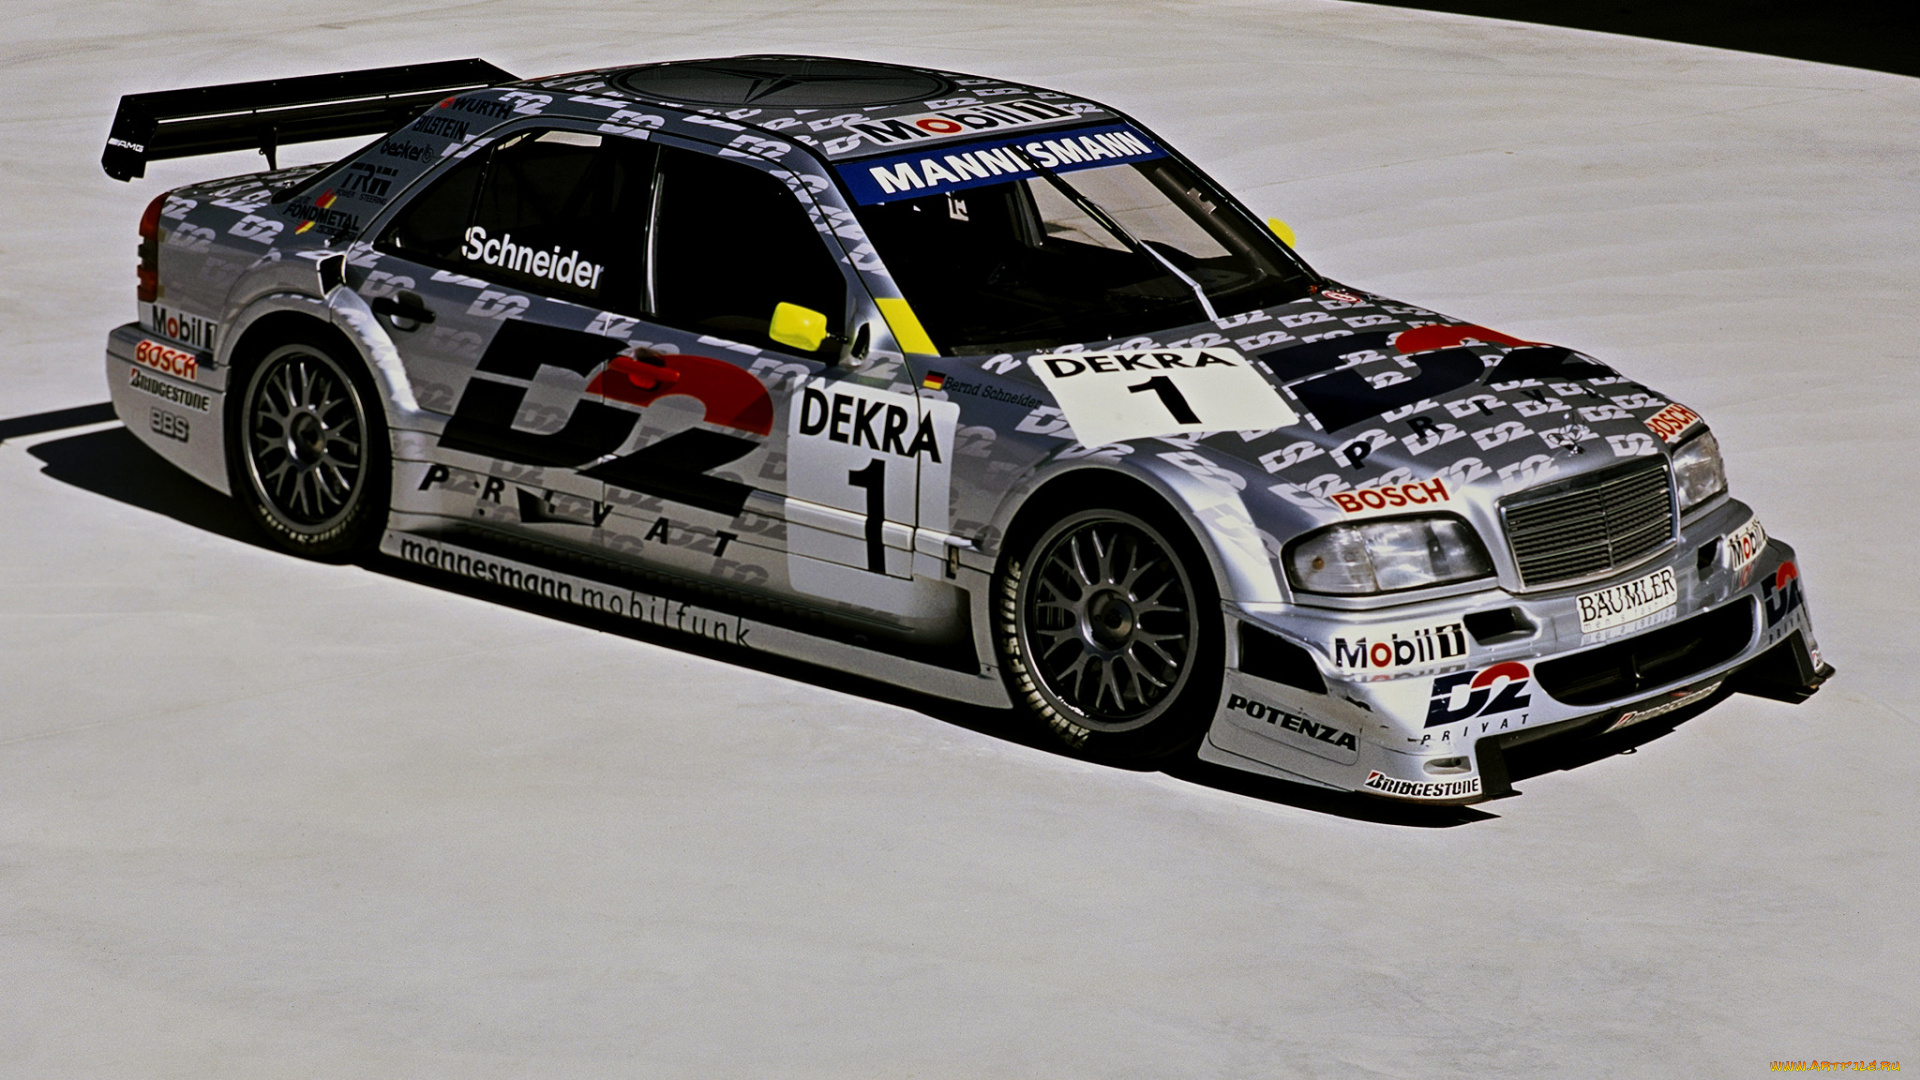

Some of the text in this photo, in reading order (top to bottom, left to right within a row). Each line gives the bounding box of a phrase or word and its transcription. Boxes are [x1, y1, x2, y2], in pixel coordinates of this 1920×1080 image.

[413, 116, 470, 140] BILSTEIN
[852, 105, 1032, 144] Mobil
[117, 139, 144, 153] AMG
[381, 139, 424, 161] becker
[282, 203, 360, 231] FONDMETAL
[462, 226, 602, 290] Schneider
[152, 304, 201, 346] Mobil
[136, 340, 197, 380] BOSCH
[1043, 351, 1239, 379] DEKRA
[131, 368, 210, 412] BRIDGESTONE
[943, 376, 981, 397] Bernd
[982, 384, 1043, 410] Schneider
[1127, 375, 1204, 425] 1
[151, 407, 189, 443] BBS
[799, 386, 943, 464] DEKRA
[1647, 402, 1699, 442] BOSCH
[1331, 477, 1451, 513] BOSCH
[848, 458, 887, 575] 1
[401, 538, 751, 648] mannesmann mobilfunk
[1578, 569, 1676, 623] BÄUMLER
[1335, 629, 1434, 668] Mobil
[1424, 661, 1532, 729] D2
[1226, 693, 1357, 751] POTENZA
[1420, 713, 1530, 746] PRIVAT
[1365, 771, 1480, 798] BRIDGESTONE
